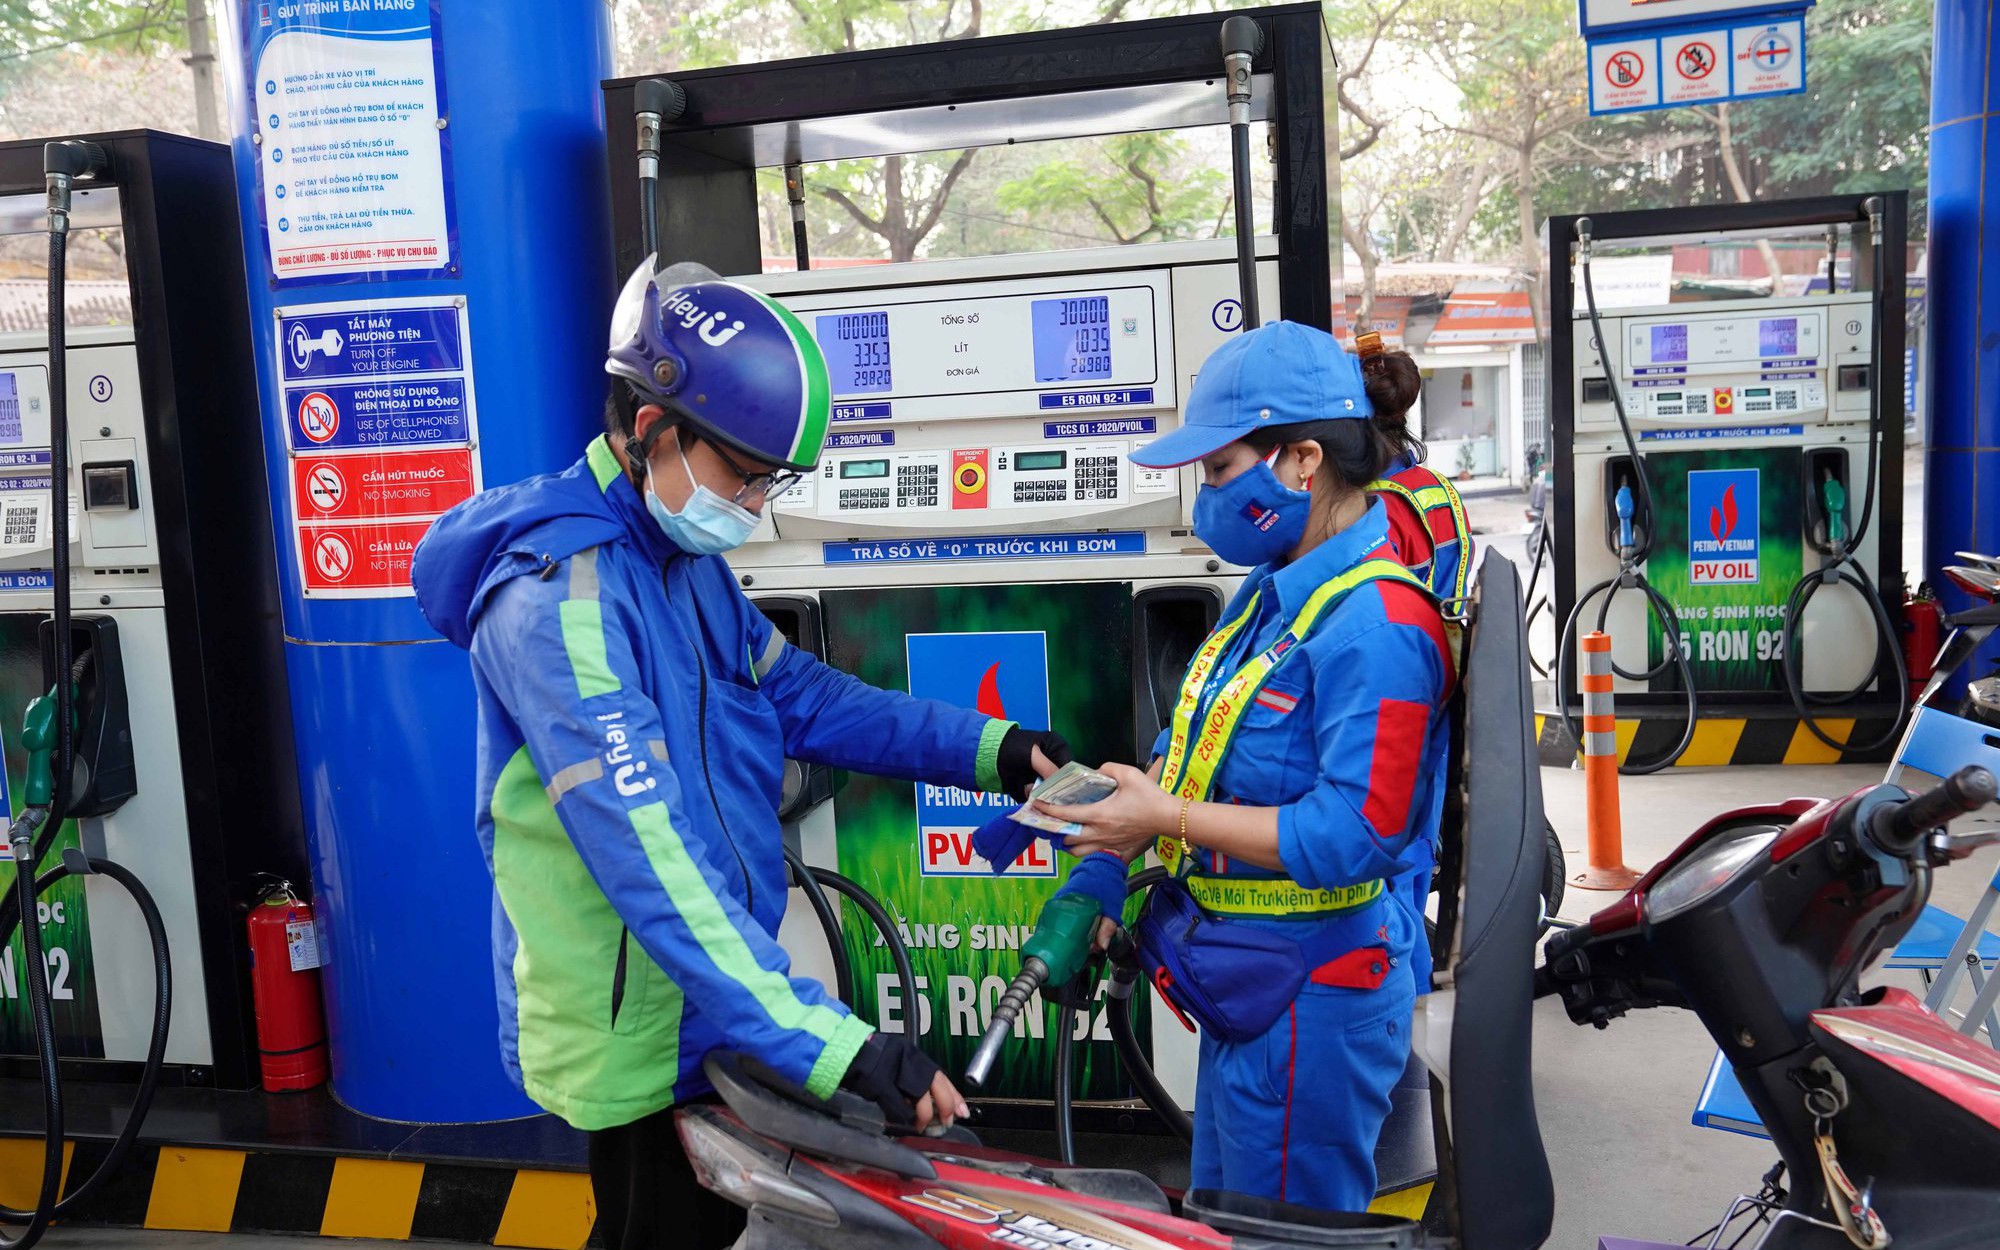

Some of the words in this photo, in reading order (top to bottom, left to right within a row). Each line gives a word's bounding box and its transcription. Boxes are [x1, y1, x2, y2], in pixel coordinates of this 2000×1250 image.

[278, 4, 300, 18] QUY
[372, 78, 399, 86] KHÁCH
[402, 78, 424, 86] HÀNG
[398, 102, 424, 110] KHÁCH
[386, 148, 409, 156] HÀNG
[940, 314, 964, 325] TỔNG
[968, 312, 980, 323] SỐ
[1060, 299, 1108, 326] 30000
[1224, 307, 1233, 323] 7
[348, 317, 366, 330] TẮT
[368, 316, 392, 328] MÁY
[838, 314, 888, 340] 100000
[349, 330, 395, 342] PHƯƠNG
[397, 328, 421, 342] TIỆN
[351, 350, 375, 359] TURN
[377, 348, 396, 357] OFF
[955, 342, 968, 352] LÍT
[352, 361, 379, 372] YOUR
[381, 359, 420, 369] ENGINE
[946, 368, 964, 376] ĐƠN
[966, 366, 980, 375] GIÁ
[854, 370, 890, 386] 29820
[98, 381, 105, 395] 3
[355, 388, 390, 399] KHÔNG
[393, 386, 406, 397] SỬ
[409, 386, 438, 397] DỤNG
[355, 398, 377, 412] ĐIỆN
[379, 400, 410, 411] THOẠI
[414, 398, 424, 408] DI
[427, 396, 459, 408] ĐỘNG
[1062, 396, 1075, 406] E5
[1078, 394, 1100, 404] RON
[1104, 393, 1130, 403] 92-II
[836, 408, 864, 419] 95-III
[357, 420, 374, 429] USE
[376, 419, 390, 429] OF
[392, 415, 459, 428] CELLPHONES
[1056, 424, 1077, 435] TCCS
[1080, 424, 1089, 433] 01
[1097, 421, 1143, 433] 2020/PVOIL
[358, 432, 366, 442] IS
[368, 431, 390, 441] NOT
[391, 429, 442, 440] ALLOWED
[840, 434, 883, 445] 2020/PVOIL
[1655, 432, 1673, 440] TRẢ
[1674, 430, 1687, 439] SỐ
[1688, 430, 1700, 438] VỀ
[1719, 428, 1749, 437] TRƯỚC
[1750, 428, 1766, 436] KHI
[1769, 426, 1790, 435] BƠM
[17, 455, 37, 463] 92-II
[362, 470, 385, 482] CẤM
[388, 469, 407, 480] HÚT
[409, 467, 445, 479] THUỐC
[364, 491, 380, 500] NO
[382, 488, 431, 499] SMOKING
[369, 540, 392, 551] CẤM
[394, 540, 413, 550] LỬA
[852, 544, 883, 559] TRẢ
[889, 542, 912, 557] SỐ
[916, 542, 937, 557] VỀ
[975, 539, 1034, 554] TRƯỚC
[1040, 541, 1068, 552] KHI
[1077, 539, 1116, 552] BƠM
[1694, 539, 1755, 552] PETROVIETNAM
[370, 561, 386, 570] NO
[389, 560, 408, 569] FIRE
[1694, 564, 1719, 579] PV
[1723, 563, 1754, 579] OIL
[18, 574, 47, 586] BƠM
[1666, 602, 1708, 619] ĂNG
[1713, 606, 1749, 618] SINH
[1700, 630, 1748, 660] RON
[1757, 631, 1784, 660] 92
[1164, 762, 1178, 788] RO
[928, 833, 978, 865] PV
[1160, 839, 1174, 860] 92
[1224, 888, 1245, 905] Môi
[1275, 888, 1314, 911] kiệm
[947, 975, 1044, 1038] RON
